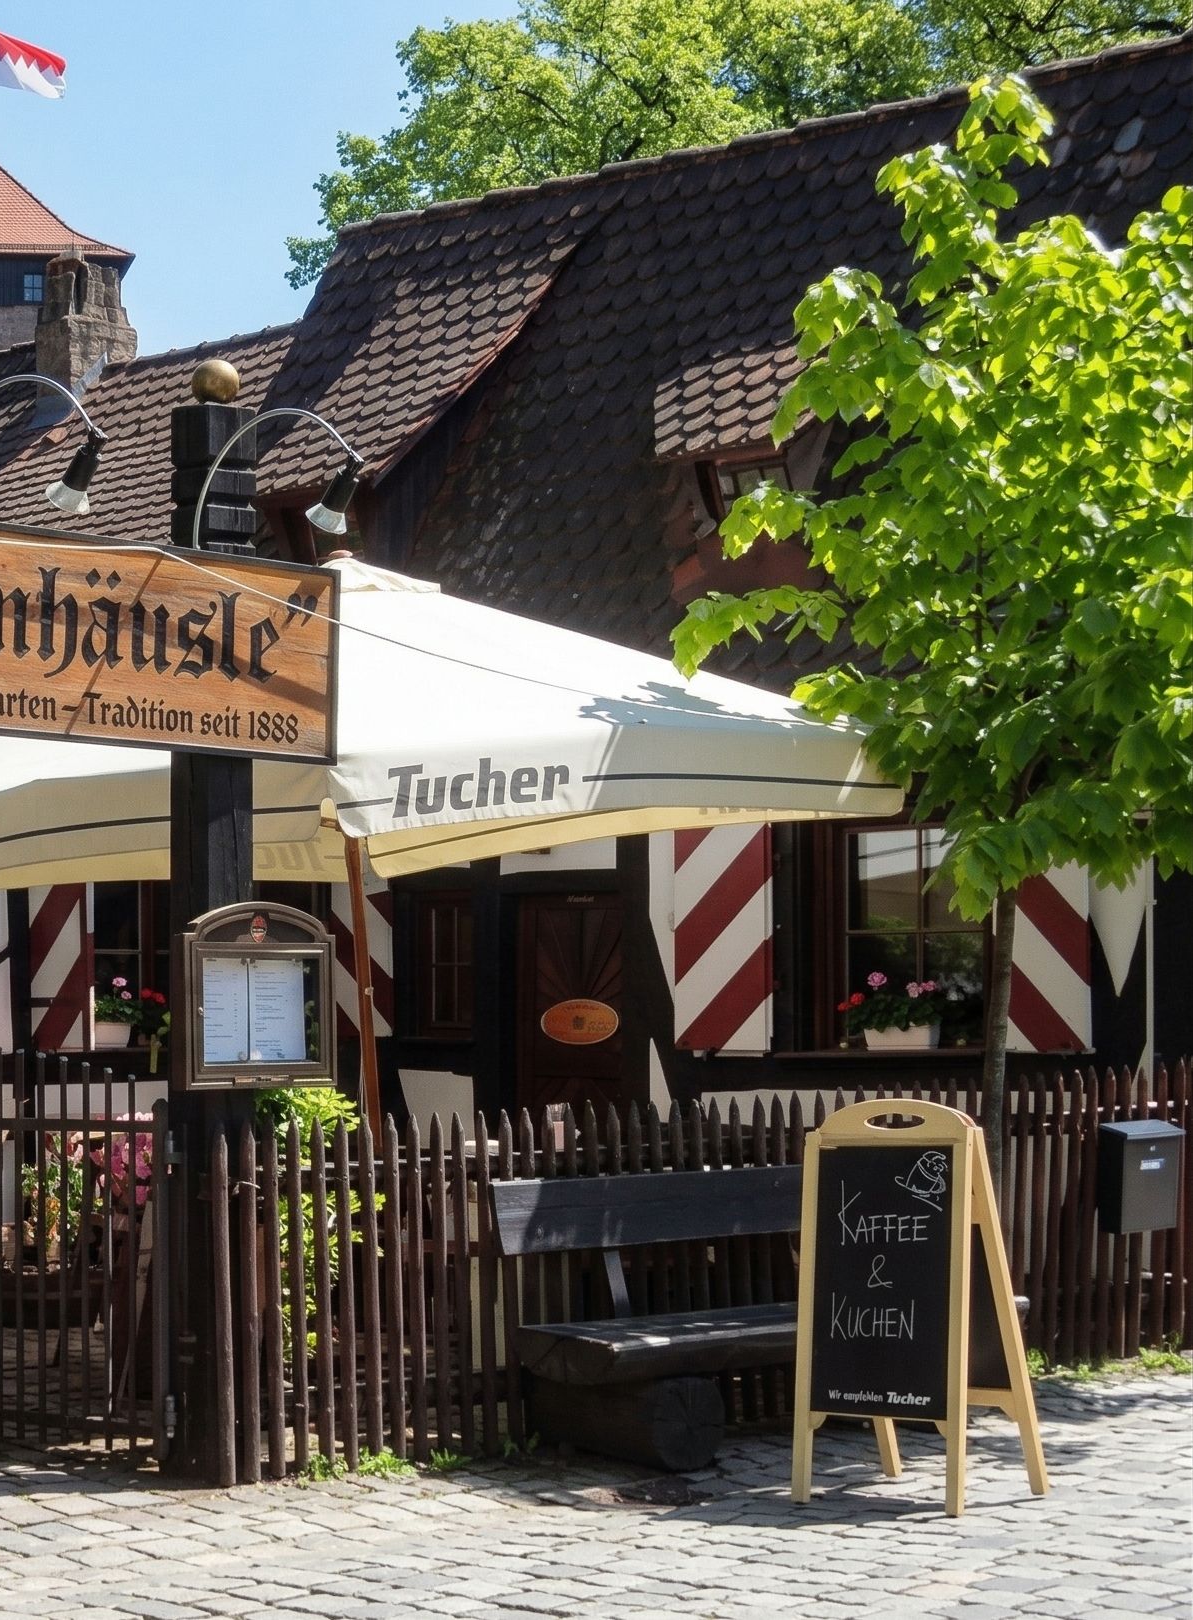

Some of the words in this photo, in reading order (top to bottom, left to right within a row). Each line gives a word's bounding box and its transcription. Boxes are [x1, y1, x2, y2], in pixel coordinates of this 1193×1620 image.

[200, 705, 241, 738] seit
[248, 710, 299, 744] 1888
[387, 757, 570, 819] Tucher
[867, 1254, 893, 1288] &
[887, 1391, 931, 1405] Tucher
